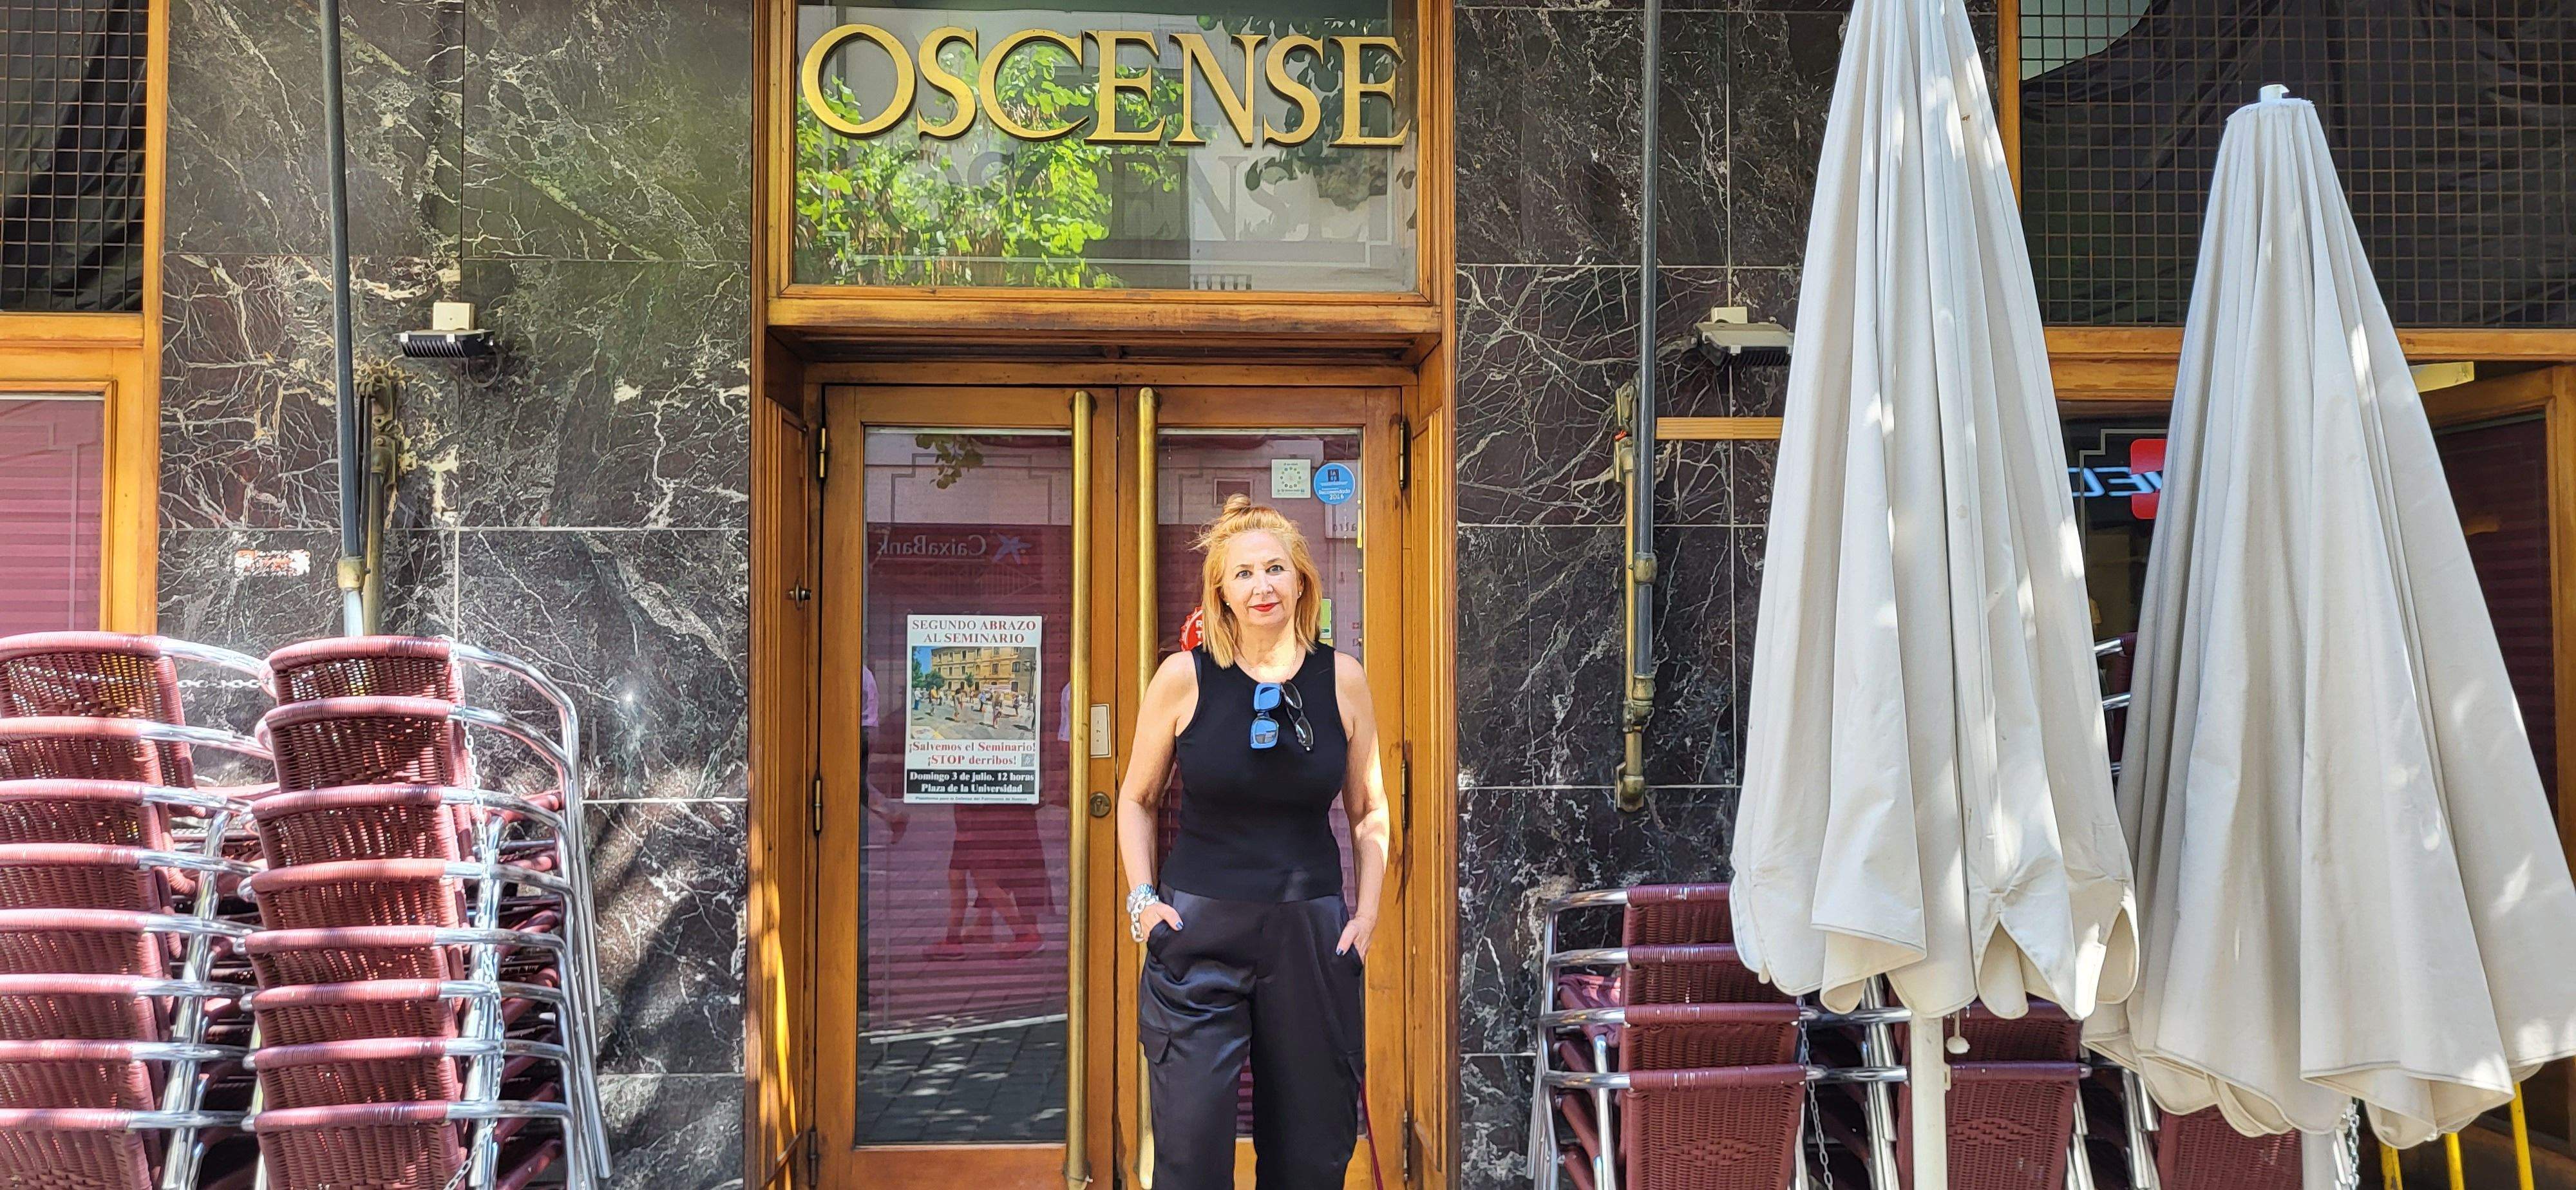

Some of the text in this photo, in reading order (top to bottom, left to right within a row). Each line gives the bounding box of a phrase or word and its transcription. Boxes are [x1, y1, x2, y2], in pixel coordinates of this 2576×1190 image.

[800, 24, 1411, 147] OSCENSE
[912, 619, 1036, 630] SEGUNDO ABRAZO
[923, 633, 1025, 643] AL SEMINARIO
[909, 741, 1036, 753] ¡Salvemos el Seminario!
[927, 755, 1017, 766] ¡STOP derribos!
[909, 771, 950, 782] Domingo
[952, 771, 958, 780] 3
[960, 771, 971, 780] de
[998, 772, 1008, 781] 12
[1009, 772, 1034, 781] horas
[921, 783, 1023, 793] Plaza de la Universidad
